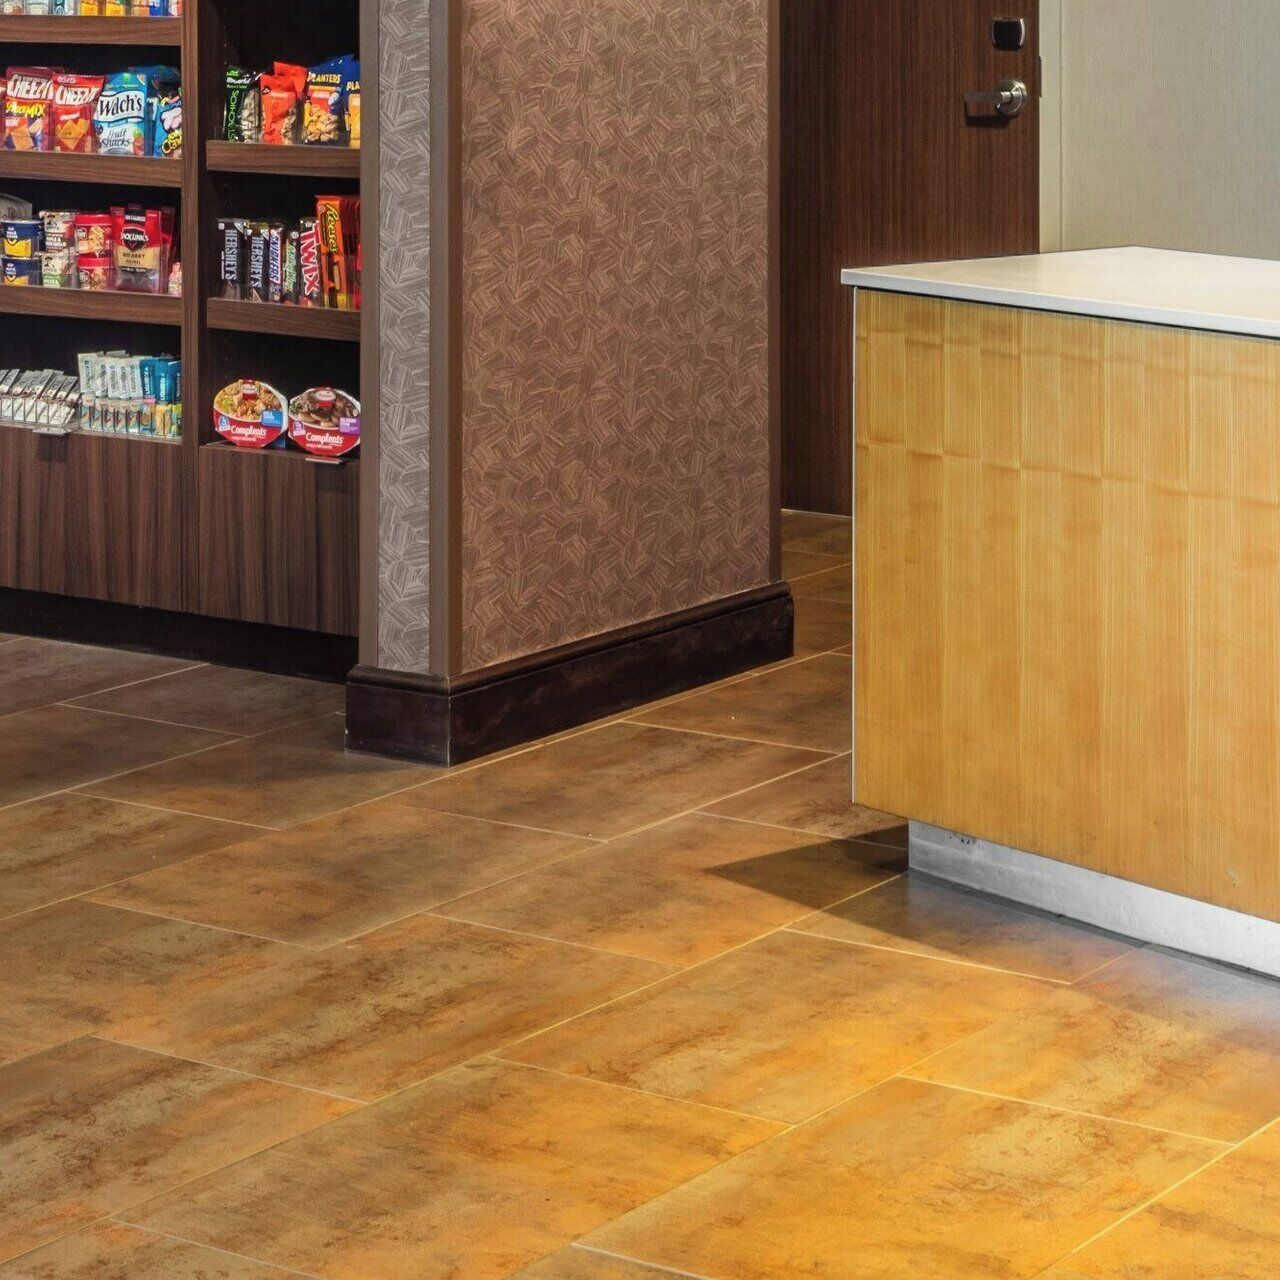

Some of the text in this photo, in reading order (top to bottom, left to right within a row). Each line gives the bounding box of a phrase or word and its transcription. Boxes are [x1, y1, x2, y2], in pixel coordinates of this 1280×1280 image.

[307, 72, 343, 84] PLANTERS
[346, 81, 360, 91] PLA
[99, 94, 142, 116] Welch's
[227, 90, 240, 141] STACHIOS
[225, 229, 238, 280] HERSHEY'S
[250, 236, 264, 288] HERSHEY'S
[269, 232, 281, 284] SNICKERS
[300, 223, 320, 296] TWIX
[230, 425, 267, 437] Compleats
[305, 432, 344, 445] Compleats
